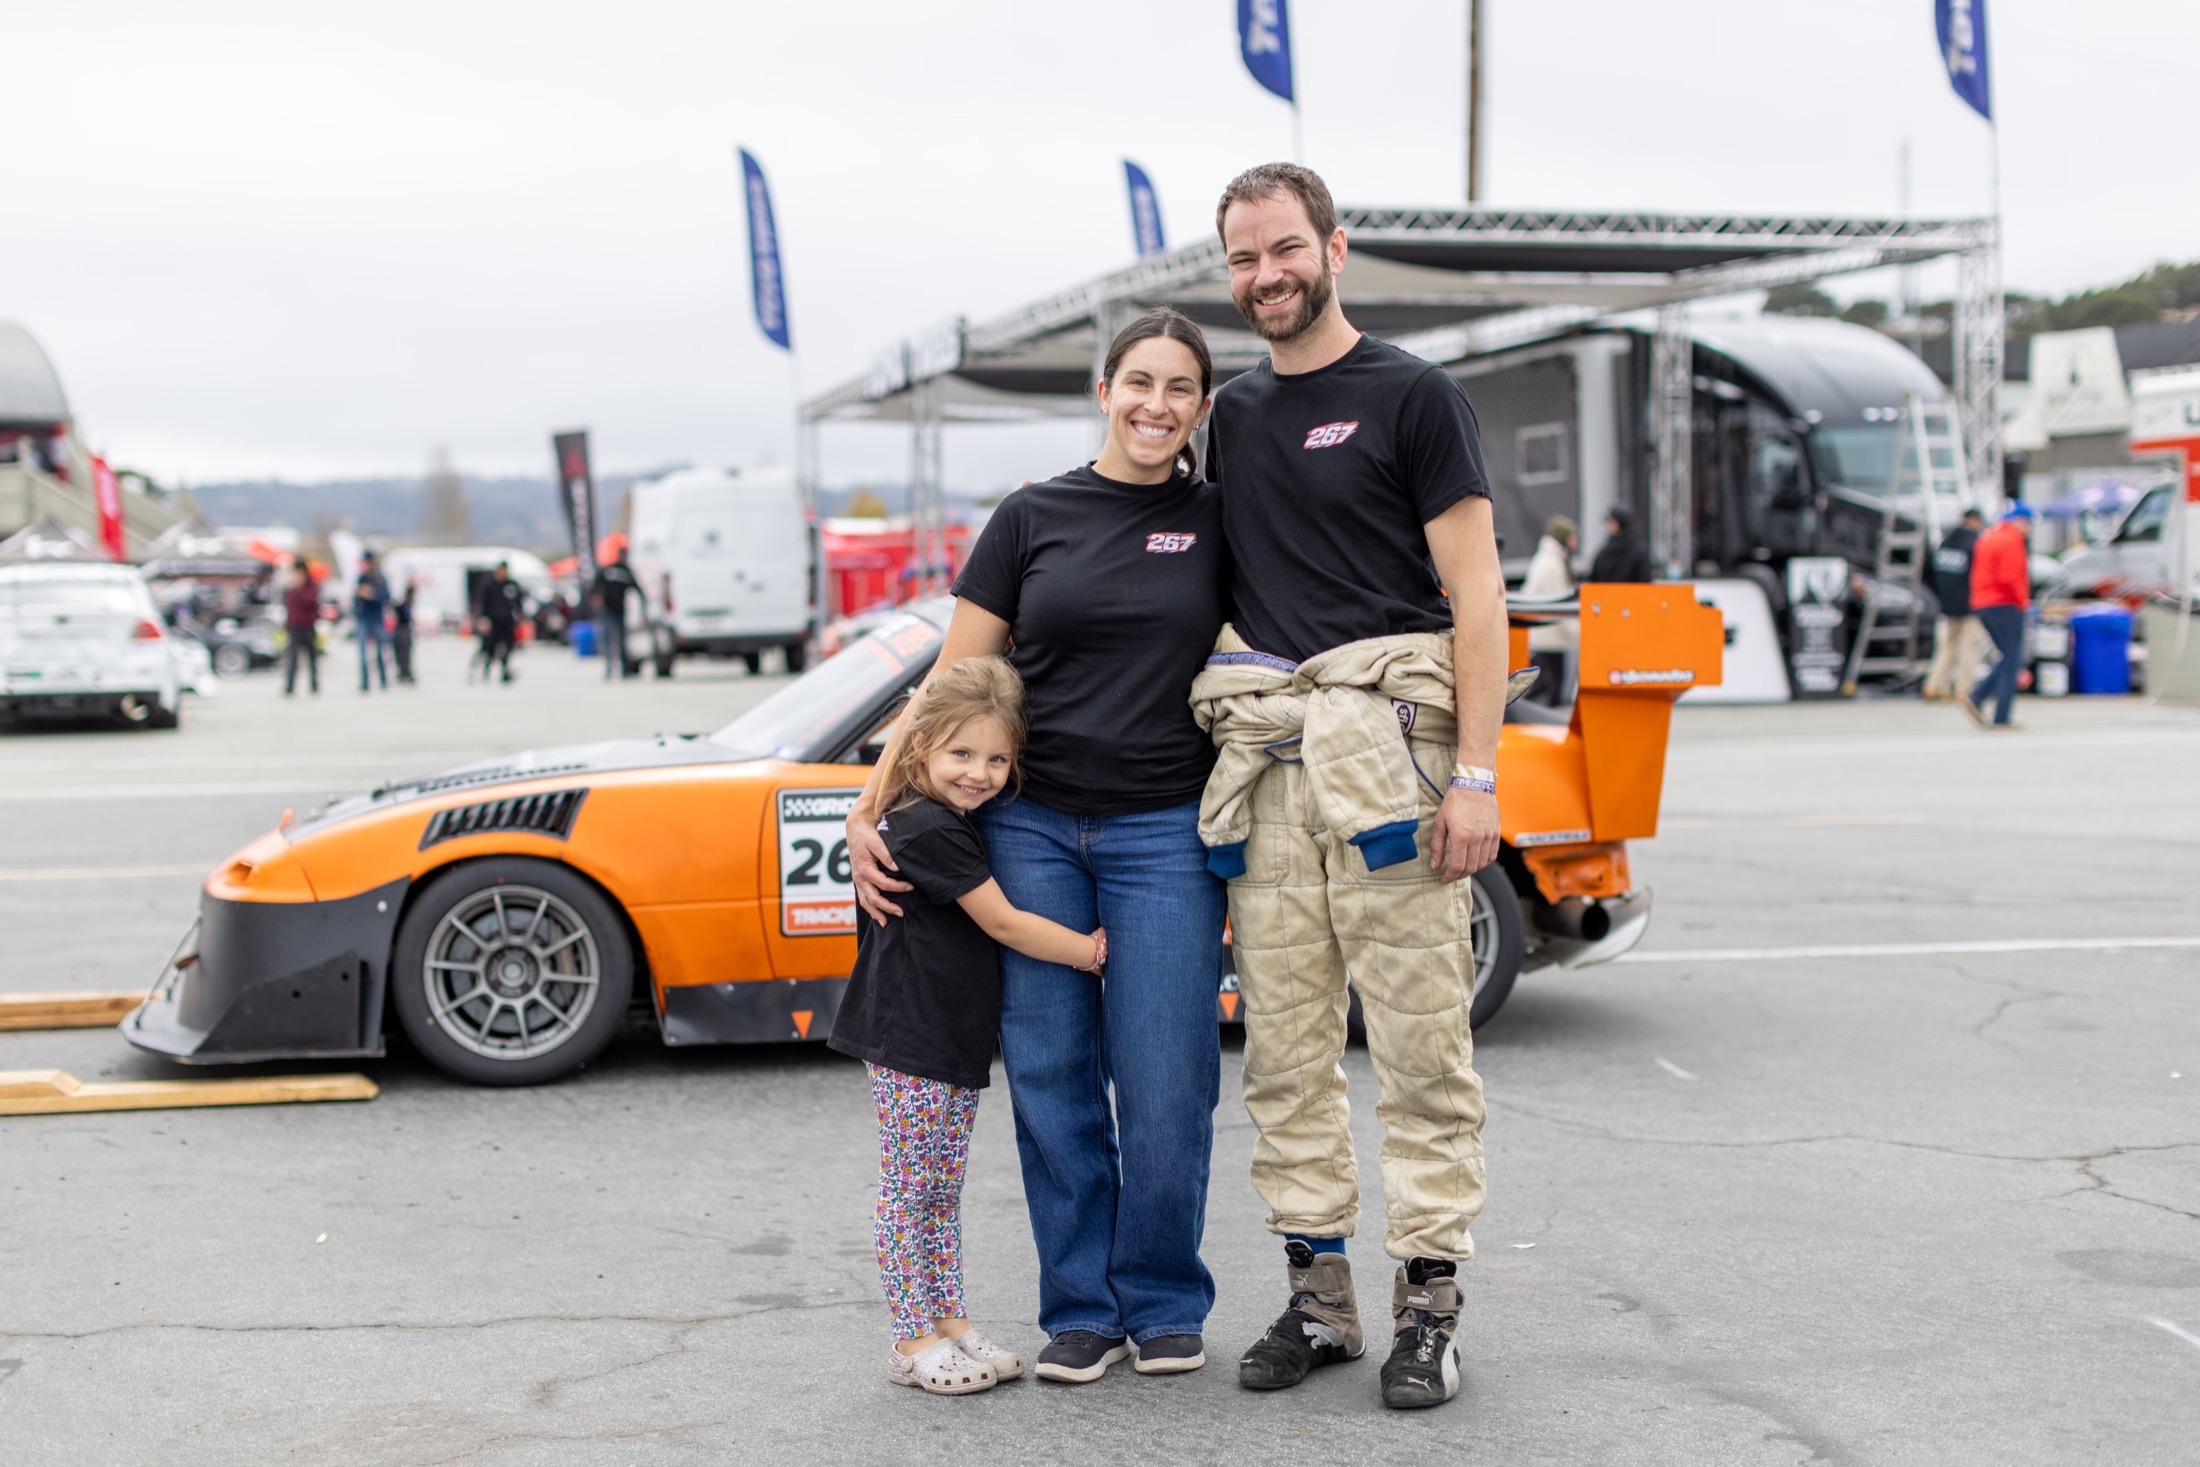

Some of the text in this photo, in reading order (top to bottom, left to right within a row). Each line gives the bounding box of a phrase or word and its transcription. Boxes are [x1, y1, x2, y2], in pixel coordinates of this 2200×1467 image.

[1303, 421, 1358, 449] 267
[1146, 532, 1197, 553] 267
[1407, 1294, 1430, 1306] PUMA
